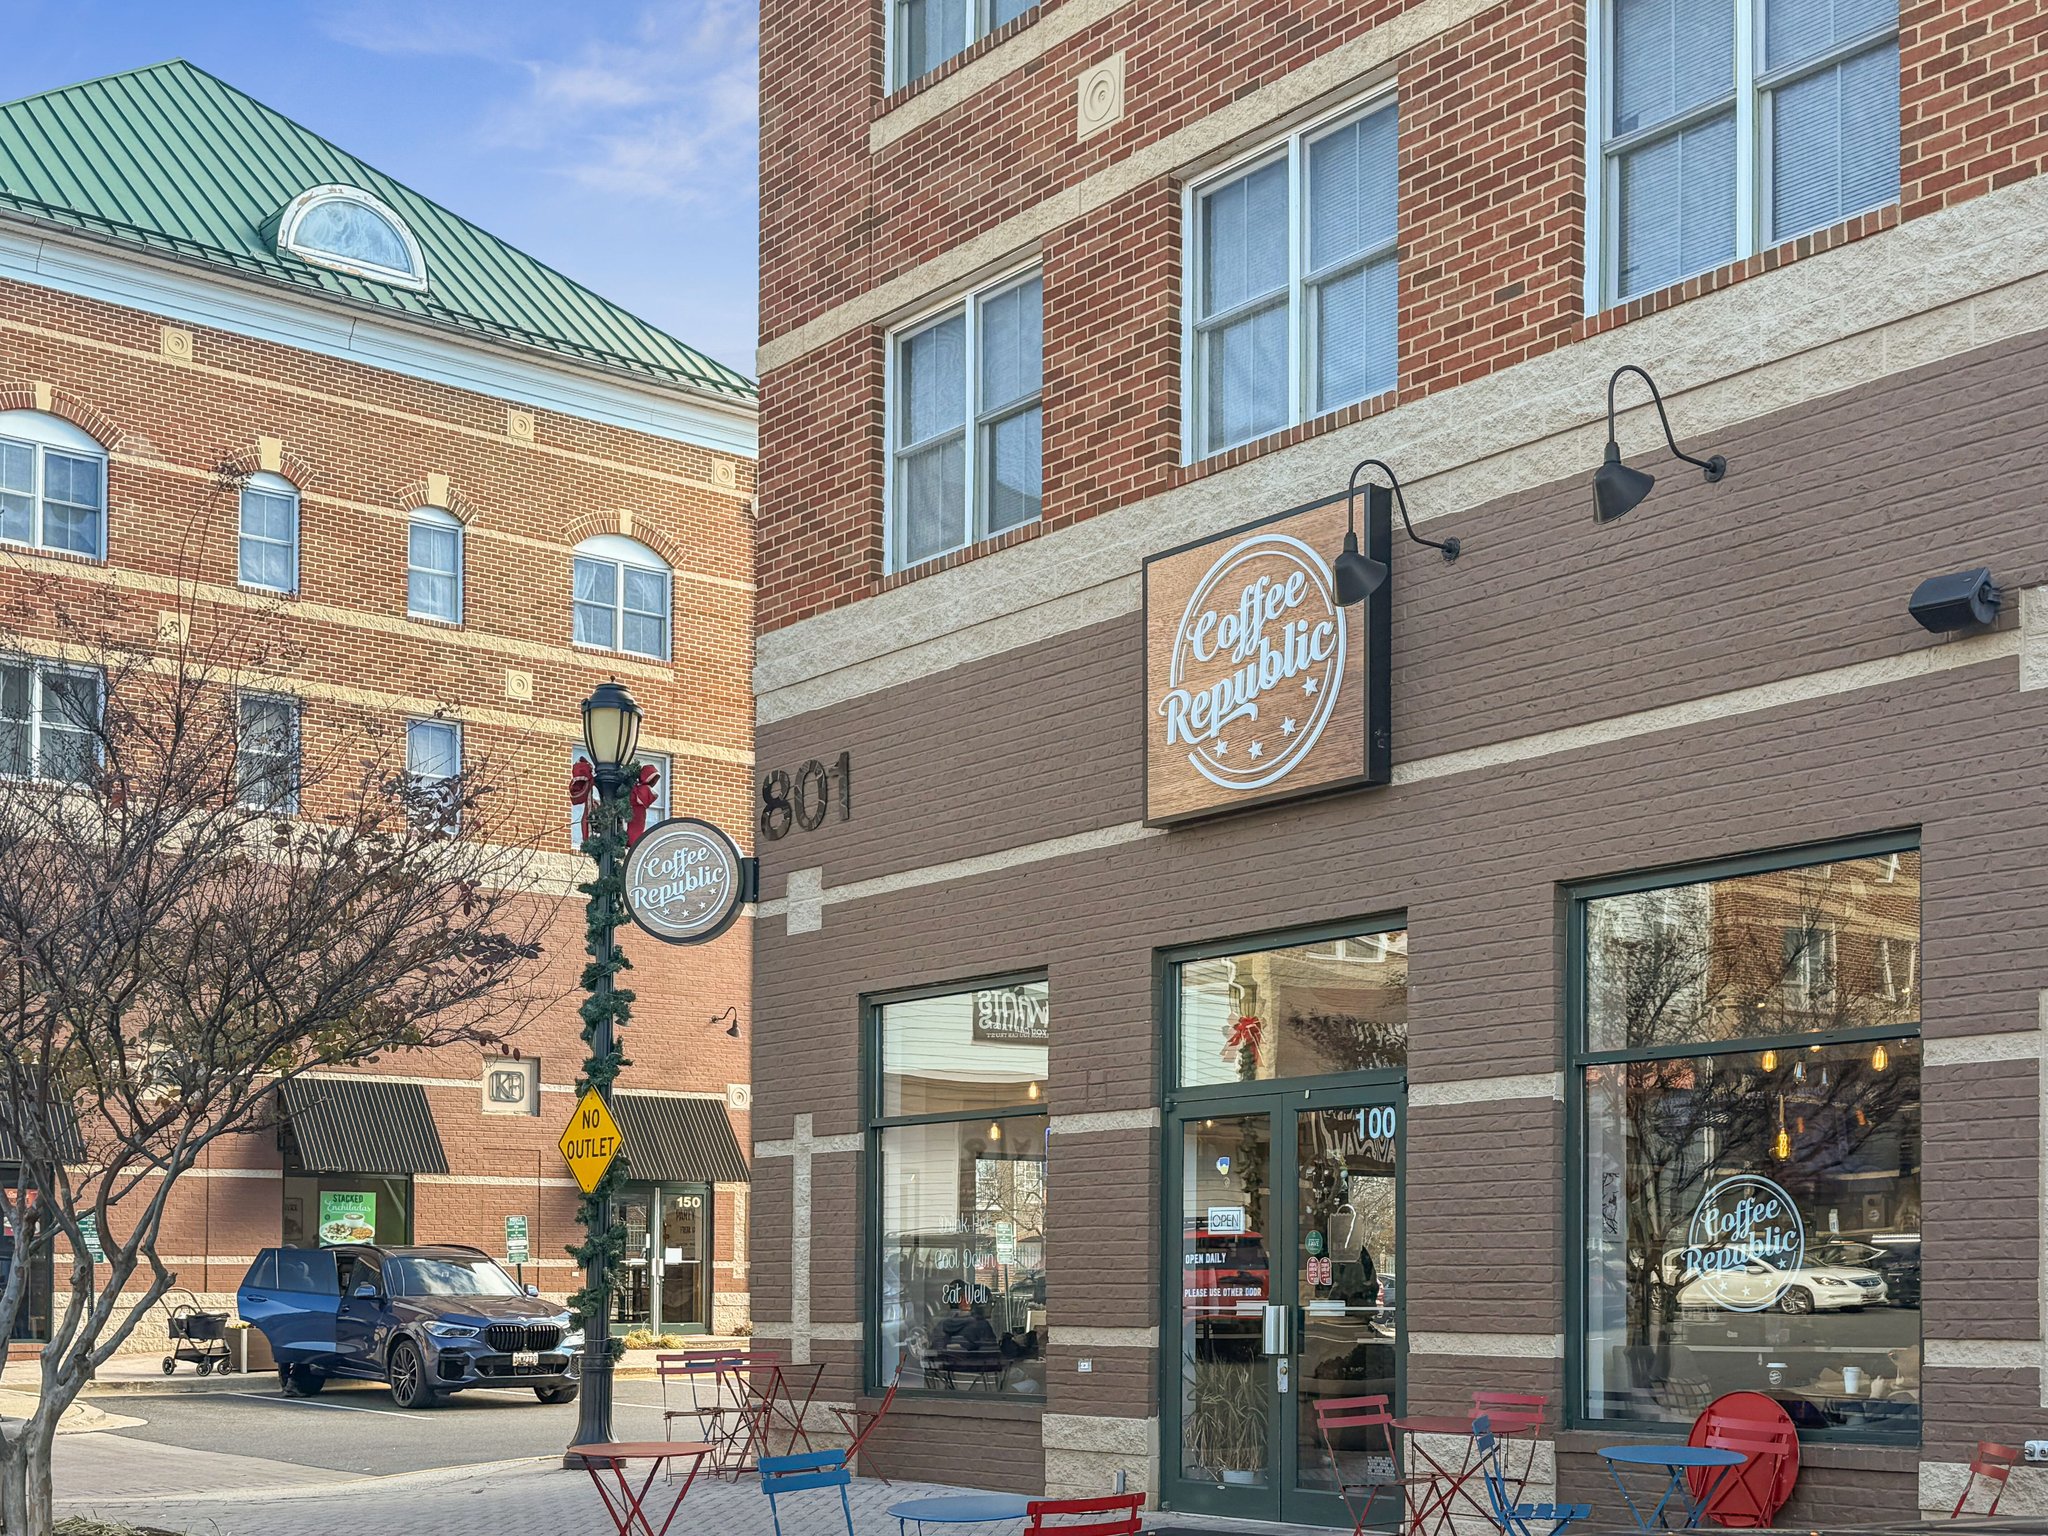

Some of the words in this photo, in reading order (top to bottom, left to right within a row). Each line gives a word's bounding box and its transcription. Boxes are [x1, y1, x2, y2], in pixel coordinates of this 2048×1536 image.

[1186, 571, 1309, 664] Coffee
[1159, 619, 1336, 745] Republic
[761, 752, 849, 841] 801
[644, 847, 710, 880] Coffee
[630, 866, 726, 910] Republic
[583, 1109, 600, 1129] NO
[1355, 1106, 1396, 1141] 100
[567, 1137, 614, 1160] OUTLET
[325, 1200, 371, 1213] Enchiladas
[333, 1194, 363, 1203] STACKED
[677, 1196, 701, 1208] 150
[1212, 1214, 1239, 1228] OPEN
[1700, 1197, 1781, 1241] Coffee
[935, 1247, 960, 1269] Cool
[963, 1249, 996, 1269] Down
[1185, 1254, 1204, 1264] OPEN
[1205, 1252, 1227, 1263] DAILY
[1681, 1226, 1799, 1280] Republic
[942, 1283, 961, 1304] Eat
[964, 1283, 989, 1304] Well
[1184, 1288, 1208, 1297] PLEASE
[1209, 1288, 1221, 1297] USE
[1222, 1287, 1243, 1297] OTHER
[1245, 1287, 1262, 1296] DOOR
